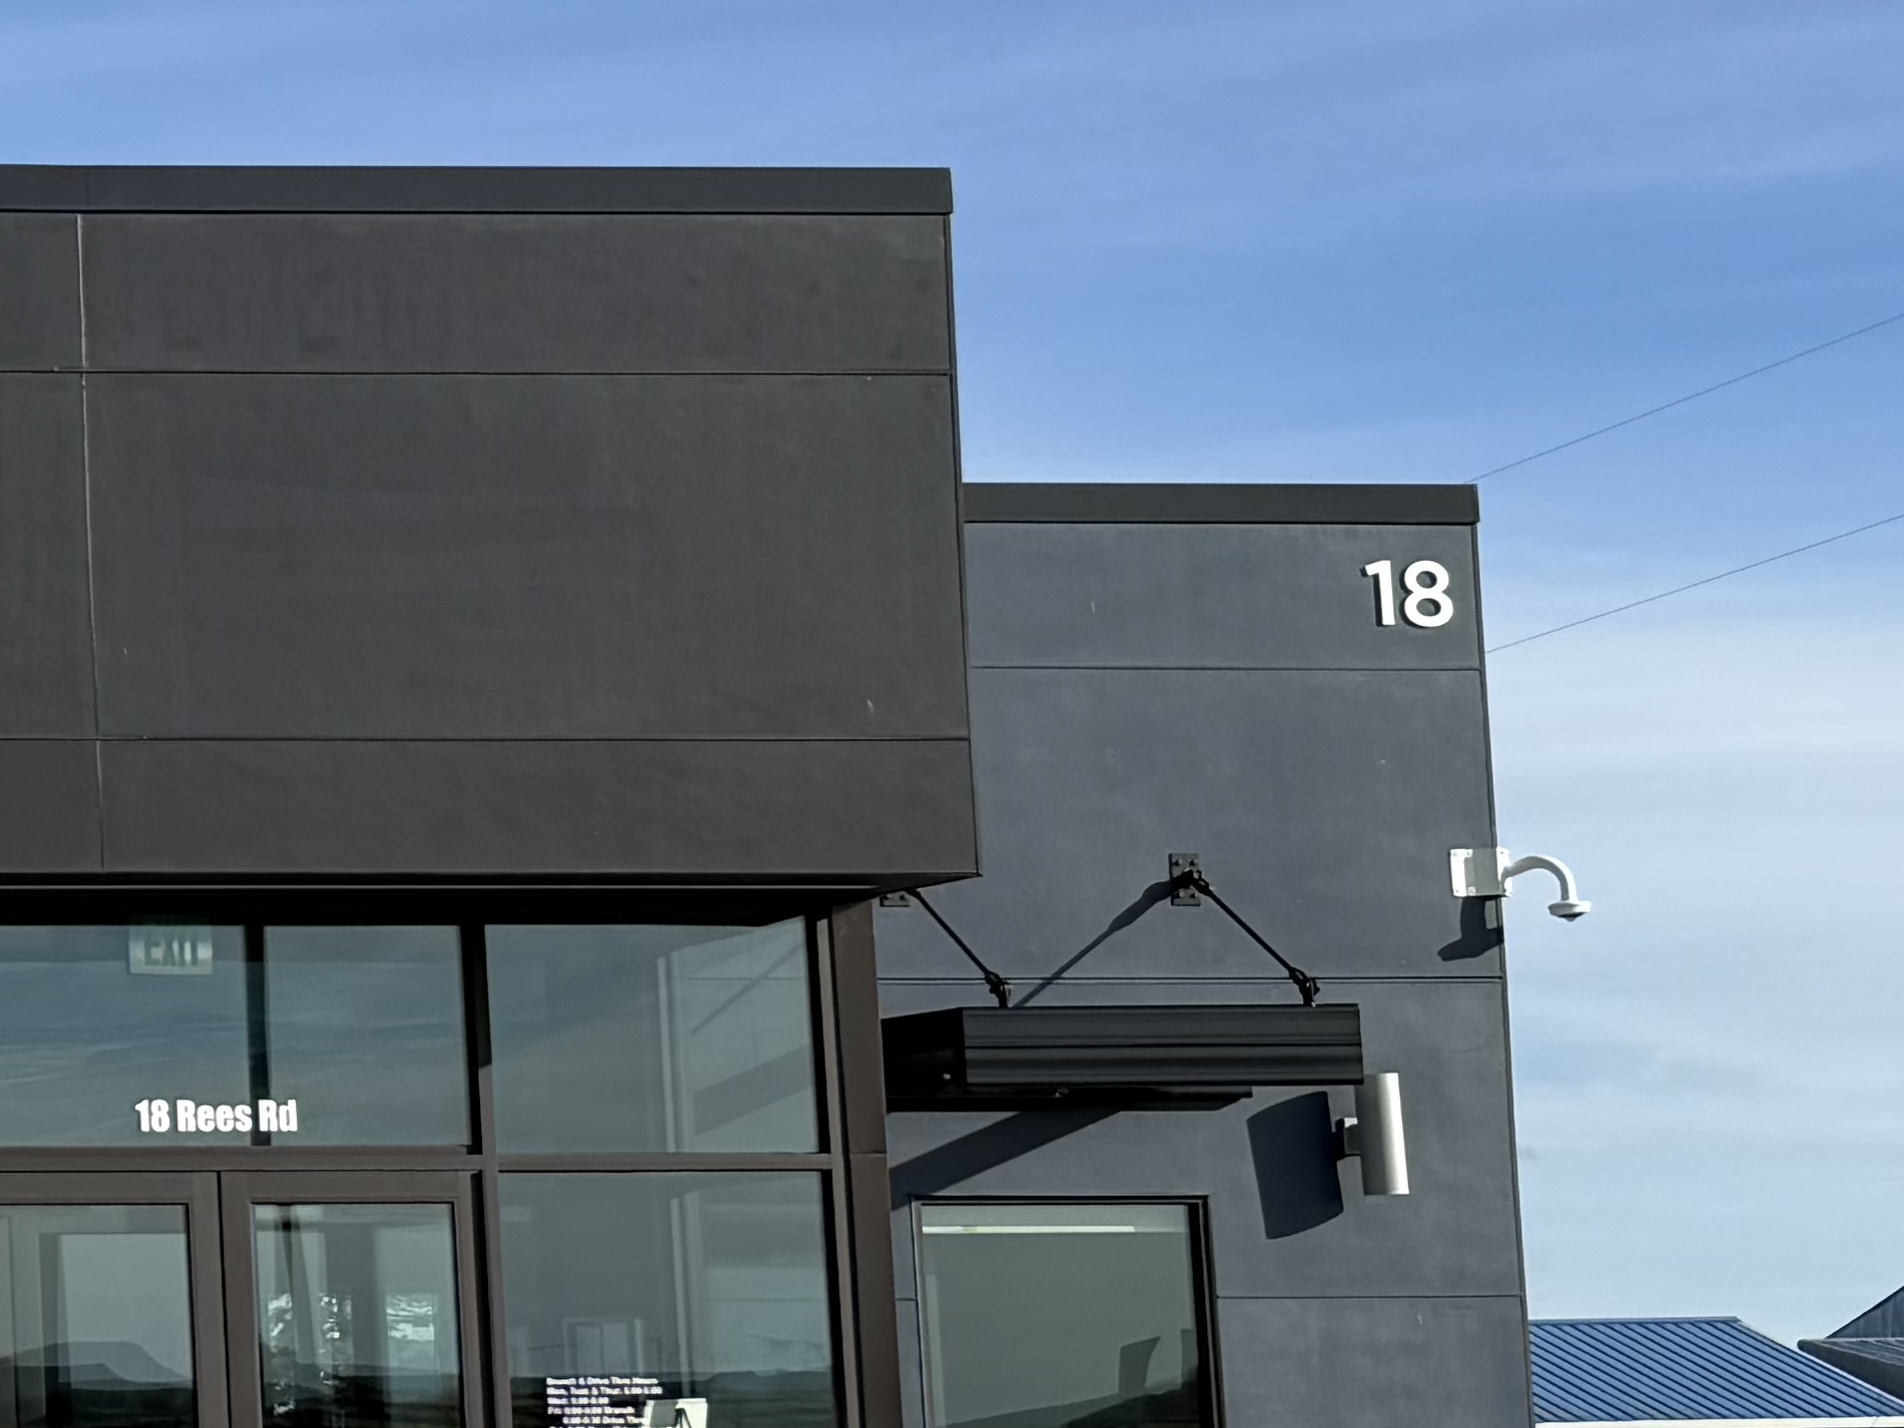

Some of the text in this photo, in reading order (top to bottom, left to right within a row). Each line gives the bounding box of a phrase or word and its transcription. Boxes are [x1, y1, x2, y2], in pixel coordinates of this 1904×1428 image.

[1363, 559, 1455, 628] 18
[135, 1098, 299, 1133] 18 Rees Rd
